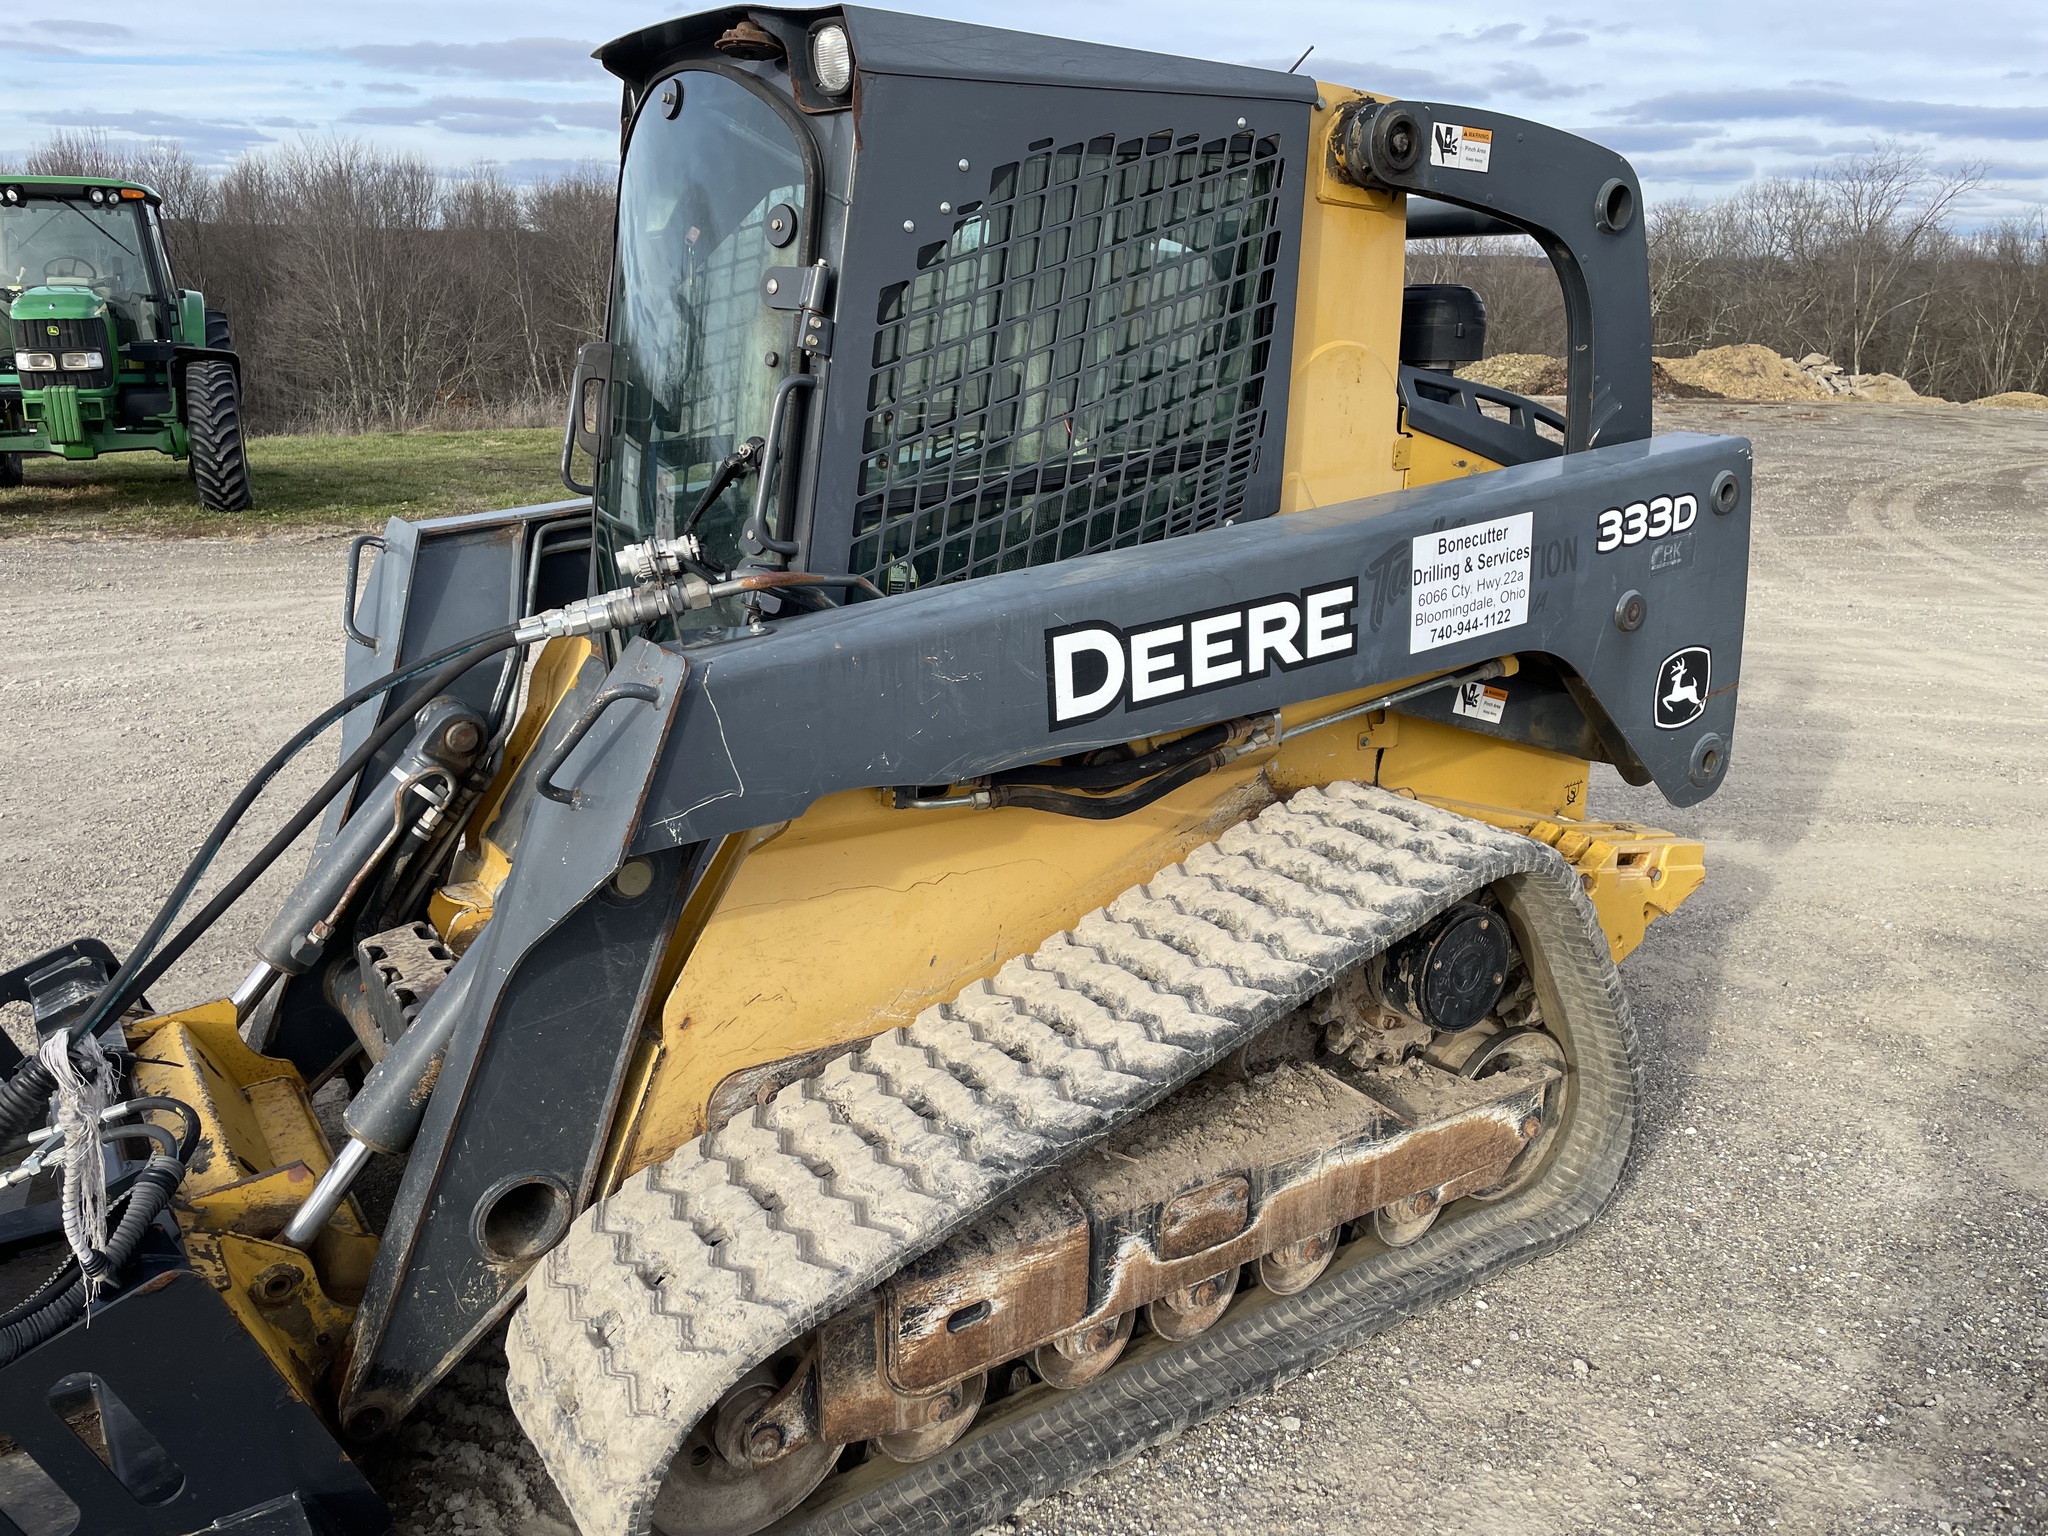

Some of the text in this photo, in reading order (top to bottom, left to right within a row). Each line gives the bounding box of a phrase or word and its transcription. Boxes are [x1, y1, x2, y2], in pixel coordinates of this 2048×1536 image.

[1468, 131, 1489, 139] WARNING
[1438, 526, 1509, 555] Bonecutter
[1597, 494, 1698, 552] 333D
[1413, 546, 1530, 586] Drilling & Services
[1415, 587, 1526, 627] Bloomingdale, Ohio
[1418, 587, 1447, 607] 6066
[1451, 582, 1473, 599] Cty.
[1430, 608, 1511, 643] 740-944-1122
[1053, 585, 1354, 722] DEERE
